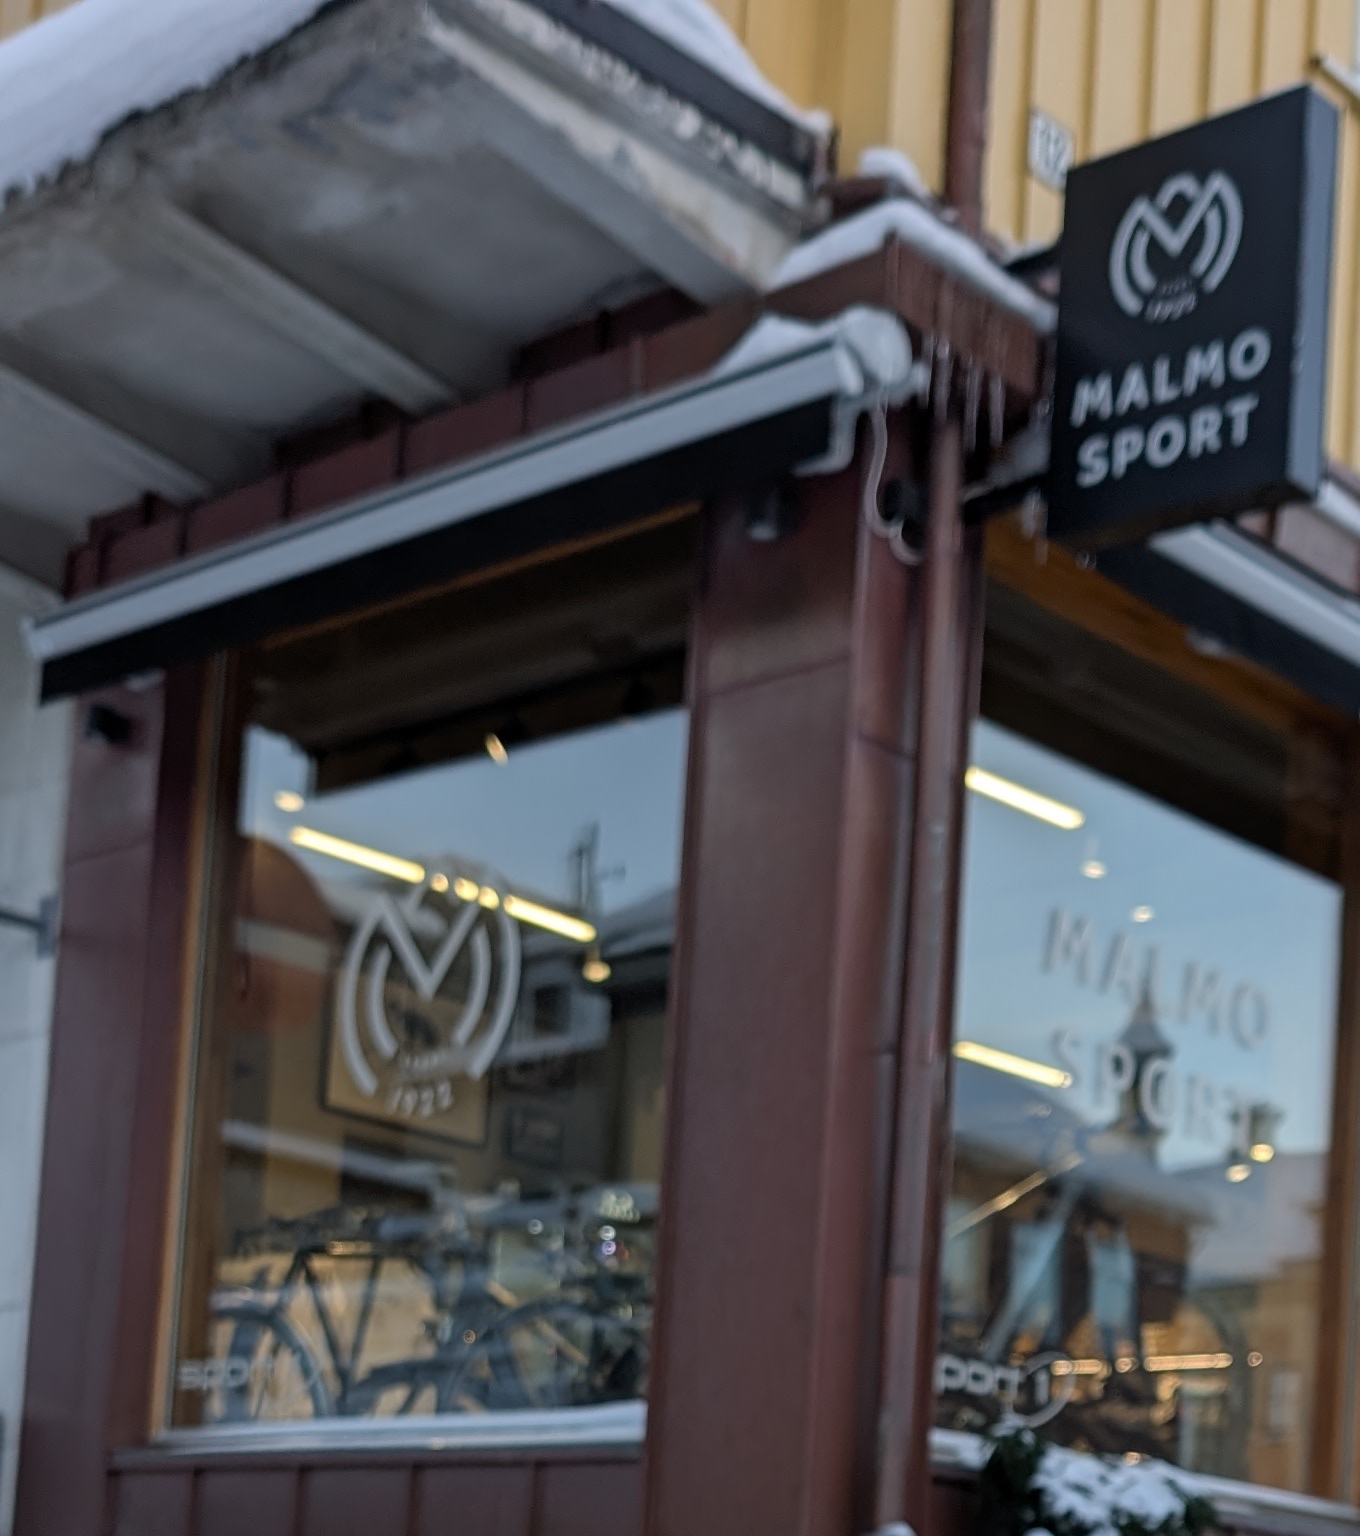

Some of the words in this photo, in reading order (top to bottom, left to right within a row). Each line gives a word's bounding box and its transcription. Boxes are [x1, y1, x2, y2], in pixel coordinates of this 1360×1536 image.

[1070, 326, 1272, 428] MALMO
[1075, 393, 1260, 489] SPORT
[1041, 906, 1270, 1050] MALMO
